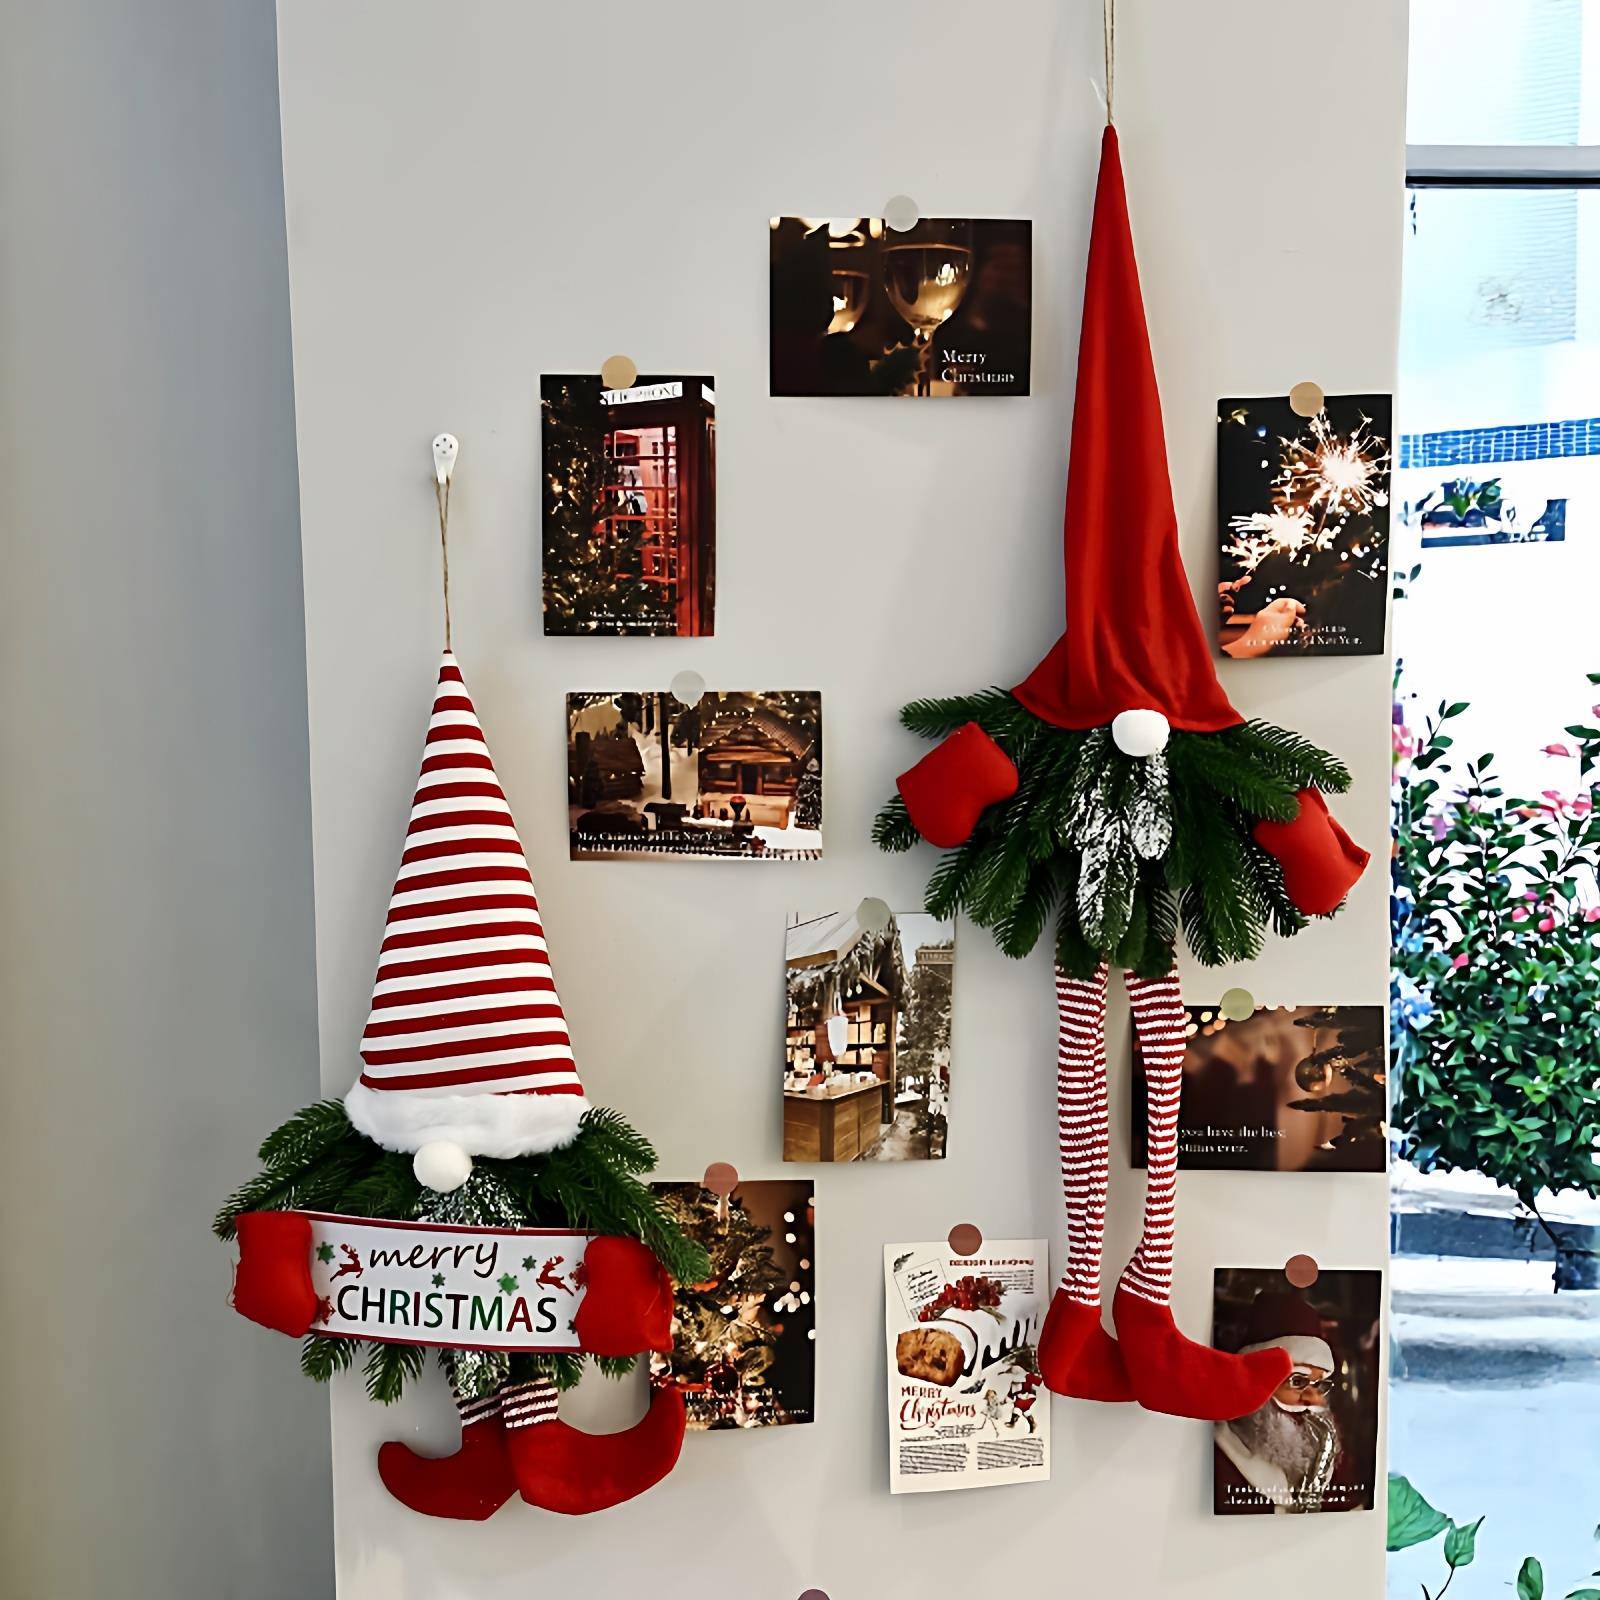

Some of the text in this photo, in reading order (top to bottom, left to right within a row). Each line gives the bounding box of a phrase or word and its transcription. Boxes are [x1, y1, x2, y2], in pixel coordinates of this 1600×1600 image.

[941, 349, 987, 365] Merry
[369, 1242, 499, 1279] merry
[336, 1285, 558, 1333] CHRISTMAS
[901, 1386, 942, 1398] MERRY
